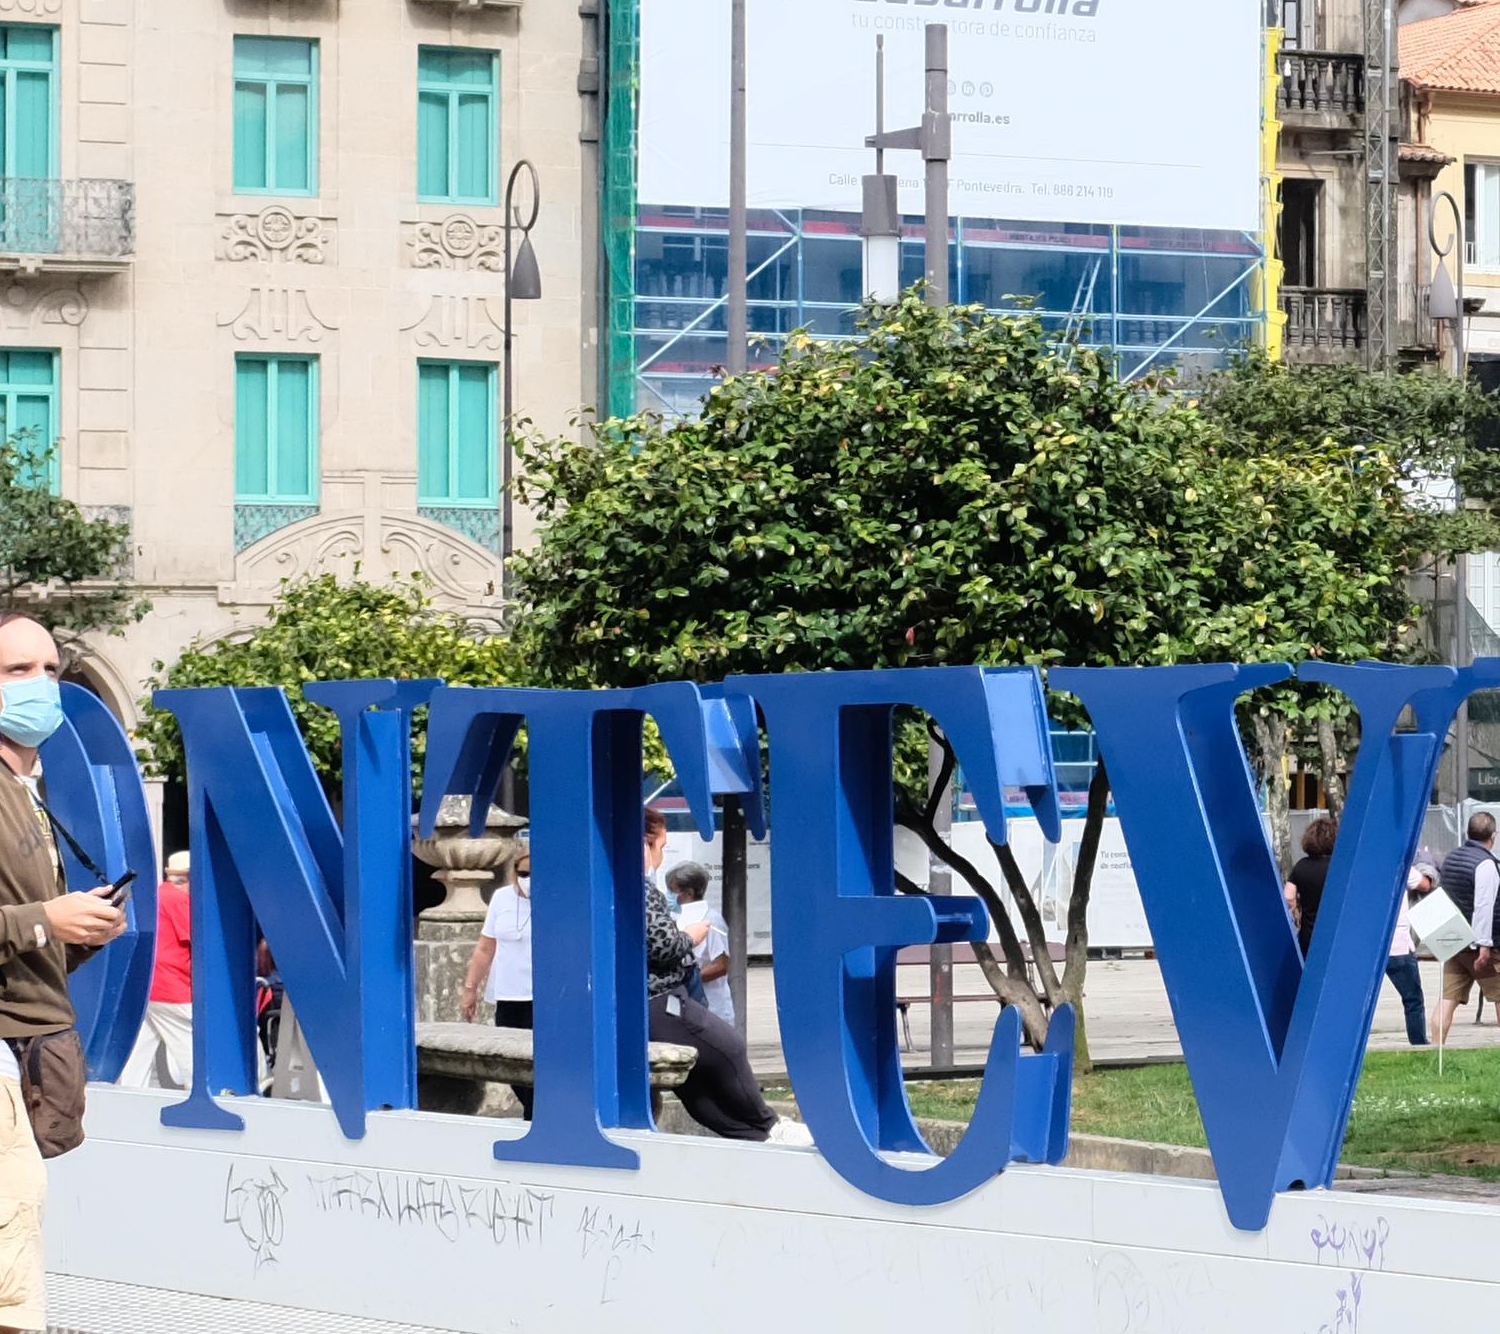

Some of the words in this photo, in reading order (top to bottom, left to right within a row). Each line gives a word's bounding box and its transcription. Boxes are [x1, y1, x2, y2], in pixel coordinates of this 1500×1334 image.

[851, 13, 869, 29] tu
[989, 19, 1011, 37] de
[1014, 21, 1097, 44] confianza
[828, 173, 858, 186] Calle
